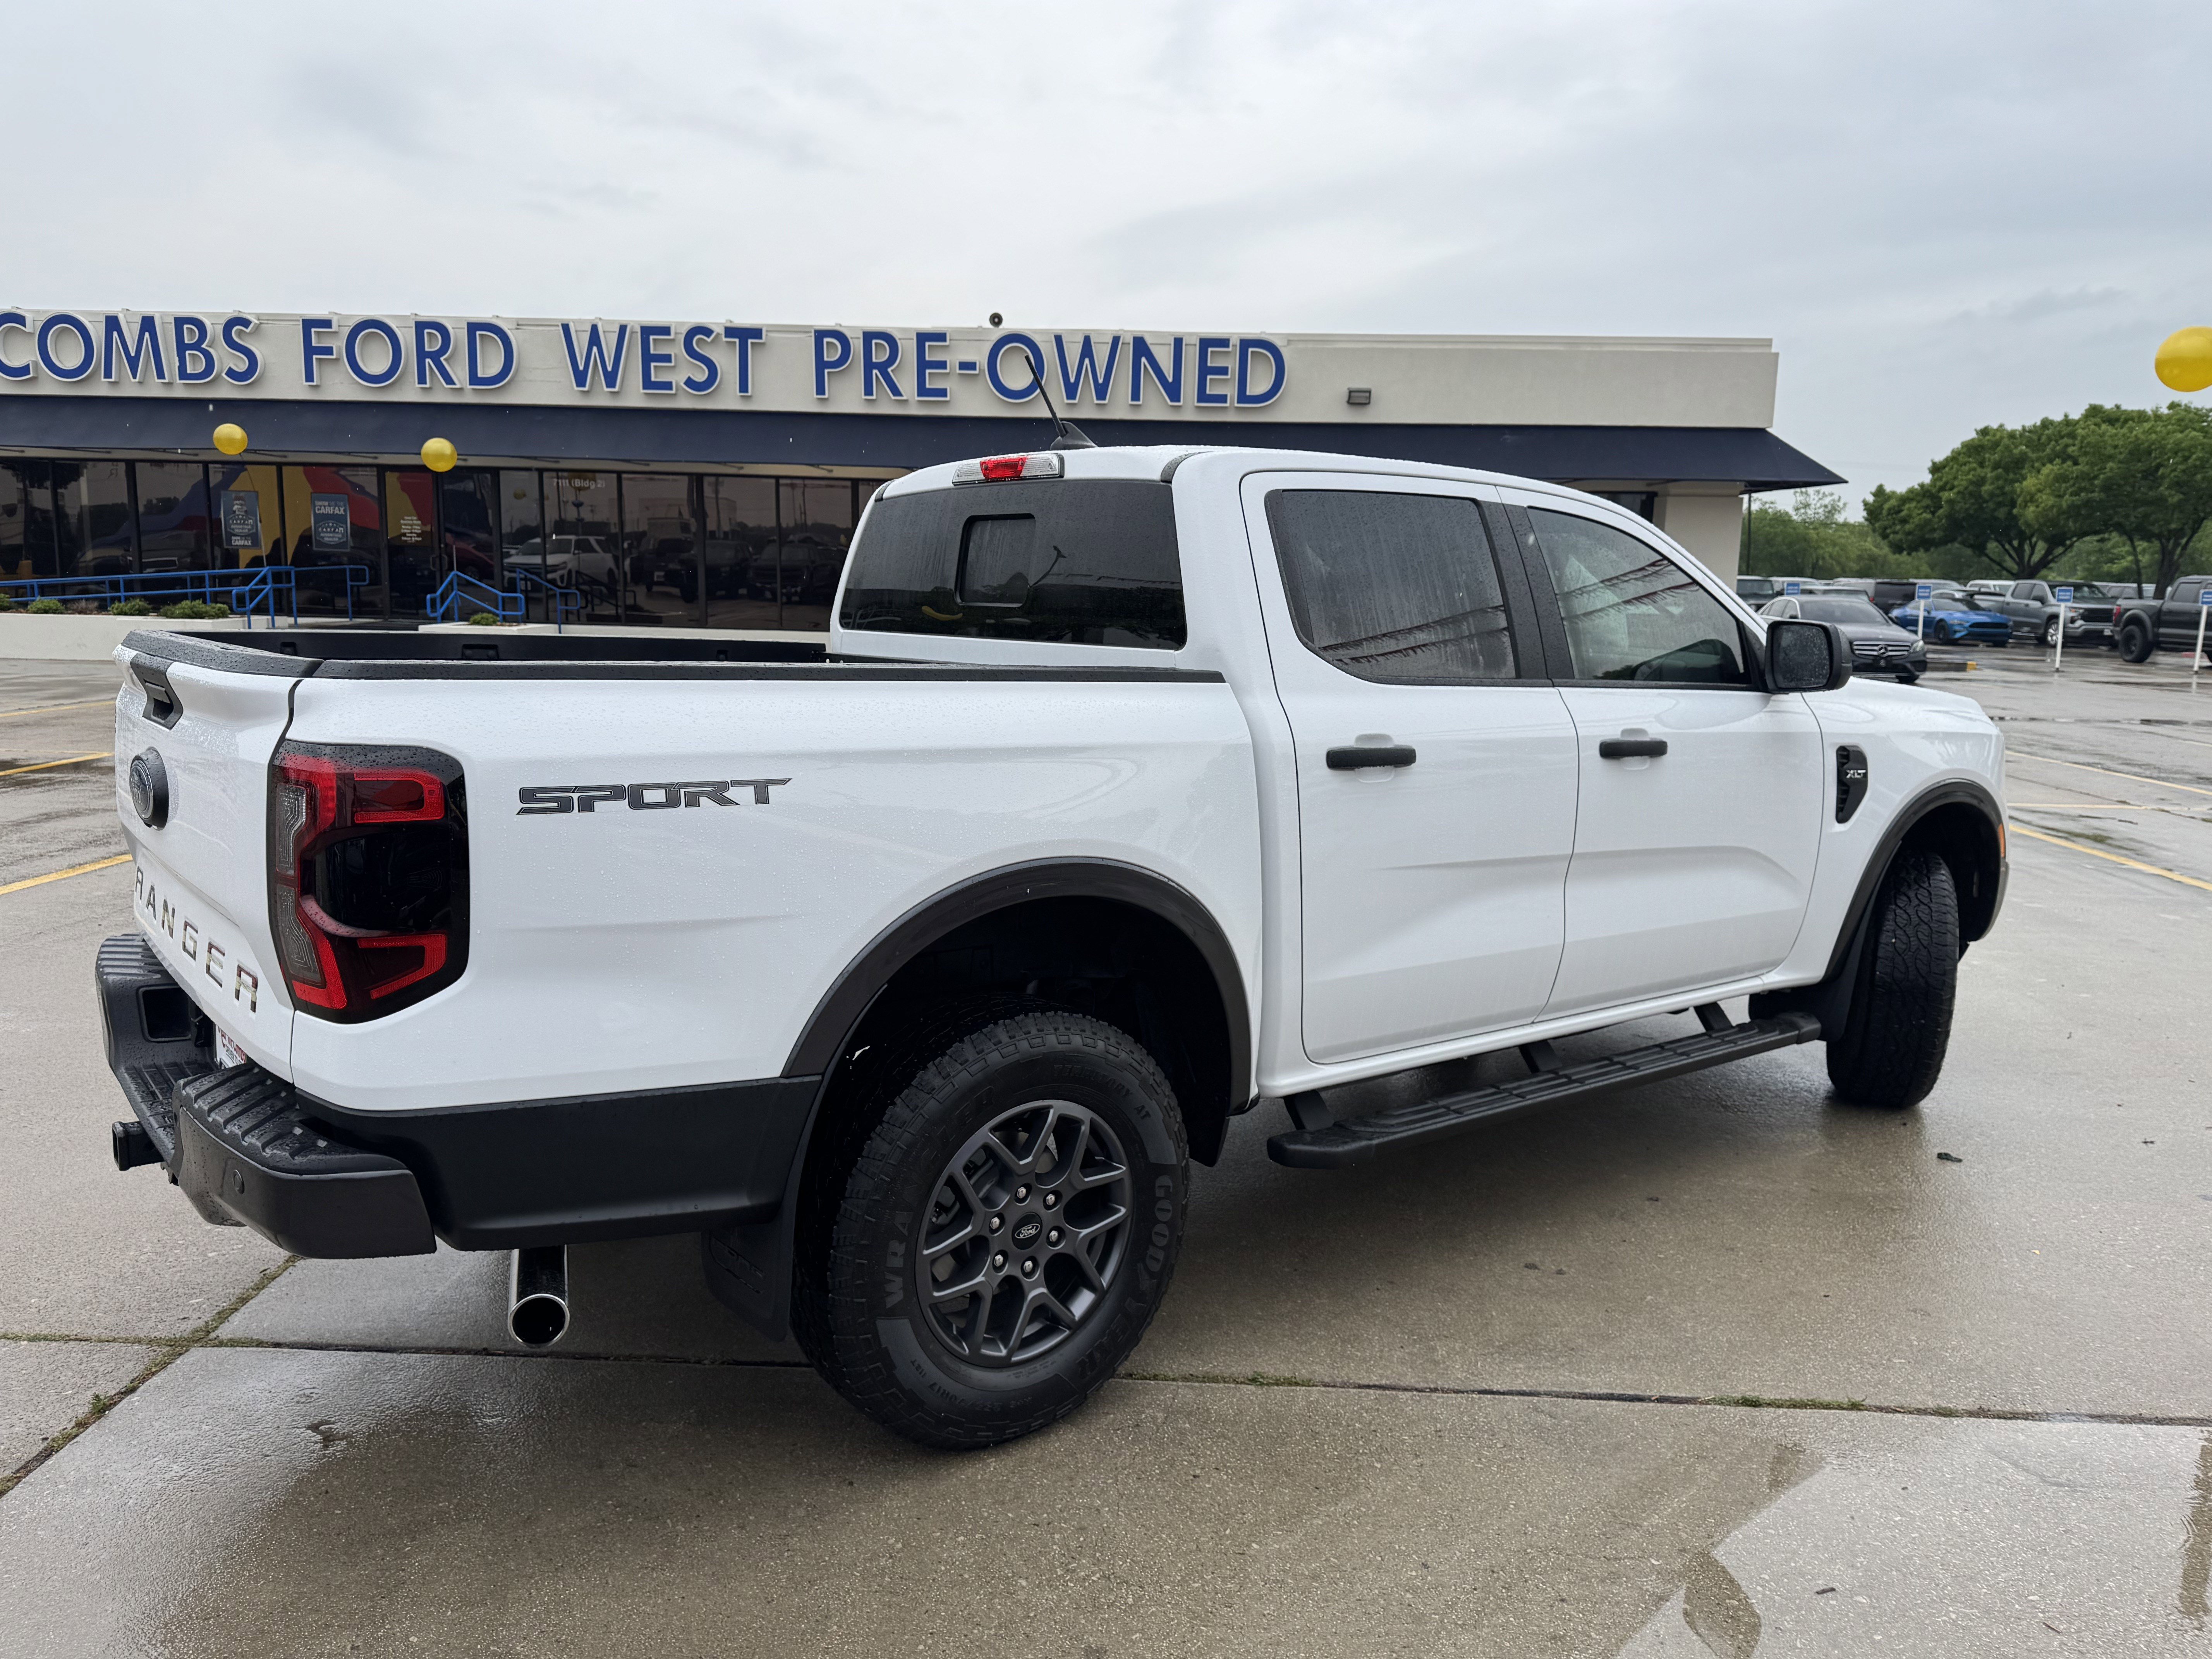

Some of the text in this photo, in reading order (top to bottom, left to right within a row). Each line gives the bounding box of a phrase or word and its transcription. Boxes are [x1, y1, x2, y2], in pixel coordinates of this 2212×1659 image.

[0, 311, 1286, 406] COMBS FORD WEST PRE-OWNED
[315, 506, 344, 514] CARFAX
[1846, 769, 1866, 778] XLT
[516, 778, 793, 815] SPORT
[136, 866, 258, 1013] RANGER
[1019, 1225, 1037, 1237] Ford
